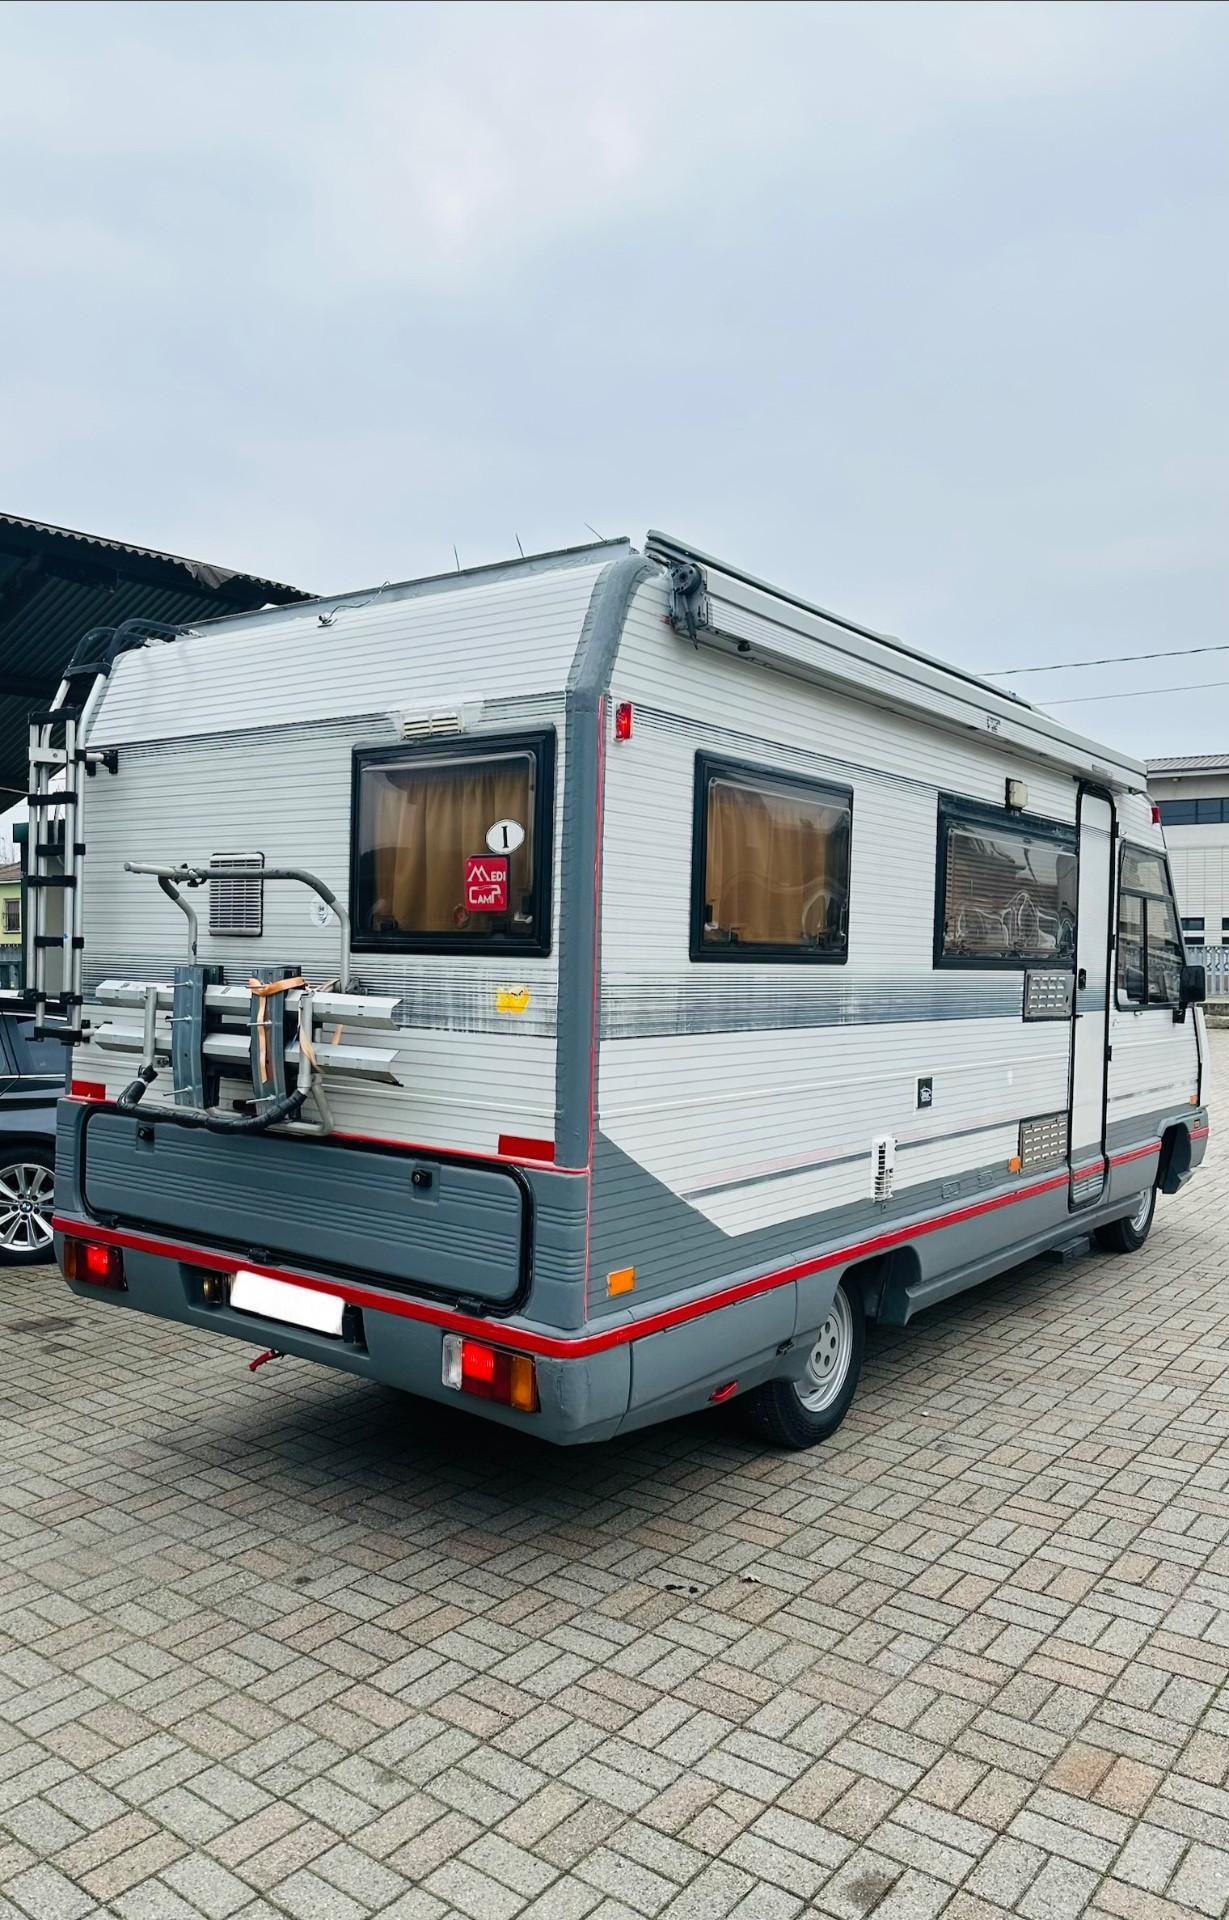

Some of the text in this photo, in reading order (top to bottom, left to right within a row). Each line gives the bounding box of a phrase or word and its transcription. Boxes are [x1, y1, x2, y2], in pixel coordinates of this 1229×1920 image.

[501, 825, 509, 848] I
[467, 865, 506, 882] MEDI
[469, 884, 501, 904] CAMP
